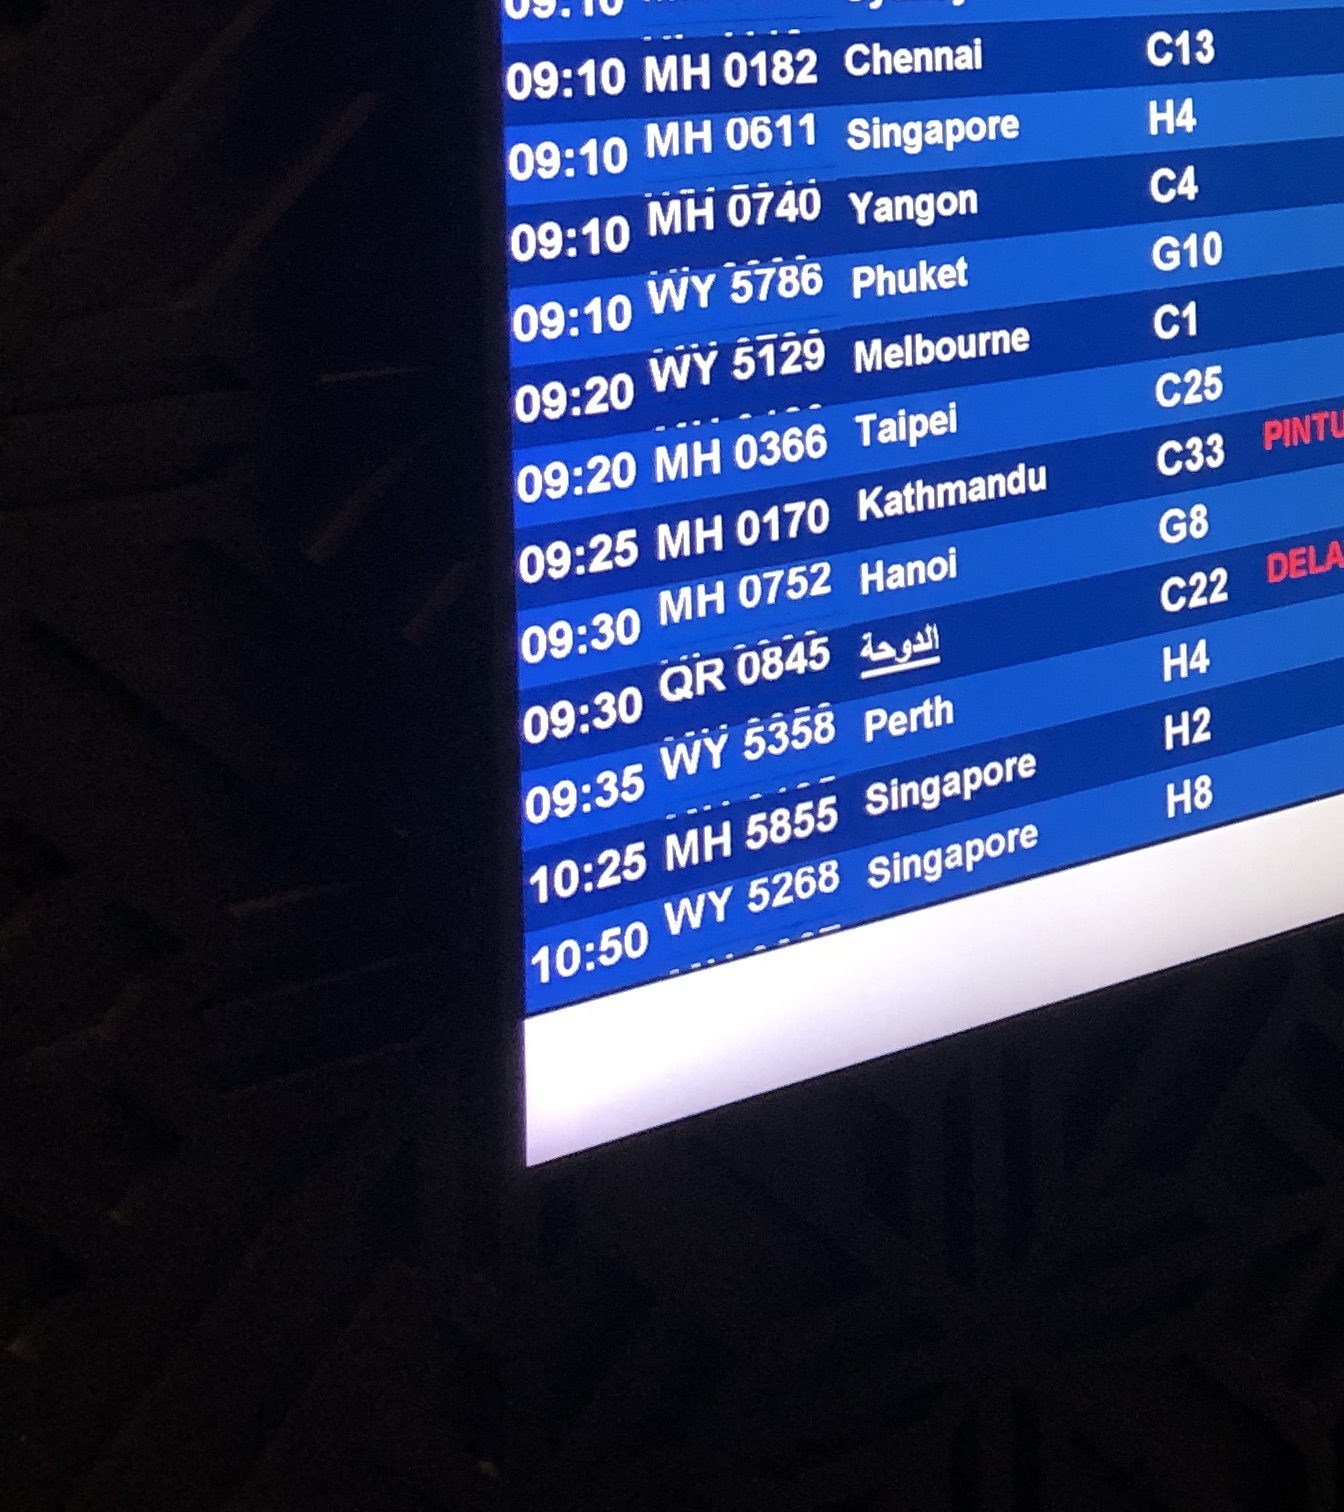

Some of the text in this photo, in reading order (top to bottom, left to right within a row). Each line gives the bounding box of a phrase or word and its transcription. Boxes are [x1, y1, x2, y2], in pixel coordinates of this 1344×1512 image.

[508, 97, 1197, 181] 09:10 MH 0611 Singapore H4
[510, 165, 1199, 262] 09:10 MH 0740 Yangon C4
[512, 230, 1223, 342] 09:10 WY 5786 Phuket G10
[514, 300, 1197, 423] 09:20 WY 5129 Melbourne C1
[519, 528, 639, 584] 09:25
[657, 514, 723, 561] MH
[736, 498, 830, 546] 0170
[858, 463, 1047, 522] Kathmandu
[1157, 433, 1225, 476] C33
[520, 503, 1209, 664] 09:30 MH 0752 Hanoi G8
[1160, 567, 1228, 612] C22
[523, 636, 830, 744] 09:30 QR 0845
[860, 623, 941, 665] الدوحة
[525, 638, 1211, 824] 09:35 WY 5358 Perth H4
[529, 706, 1211, 904] 10:25 MH 5855 Singapore H2
[531, 774, 1213, 984] 10:50 WY 5268 Singapore H8
